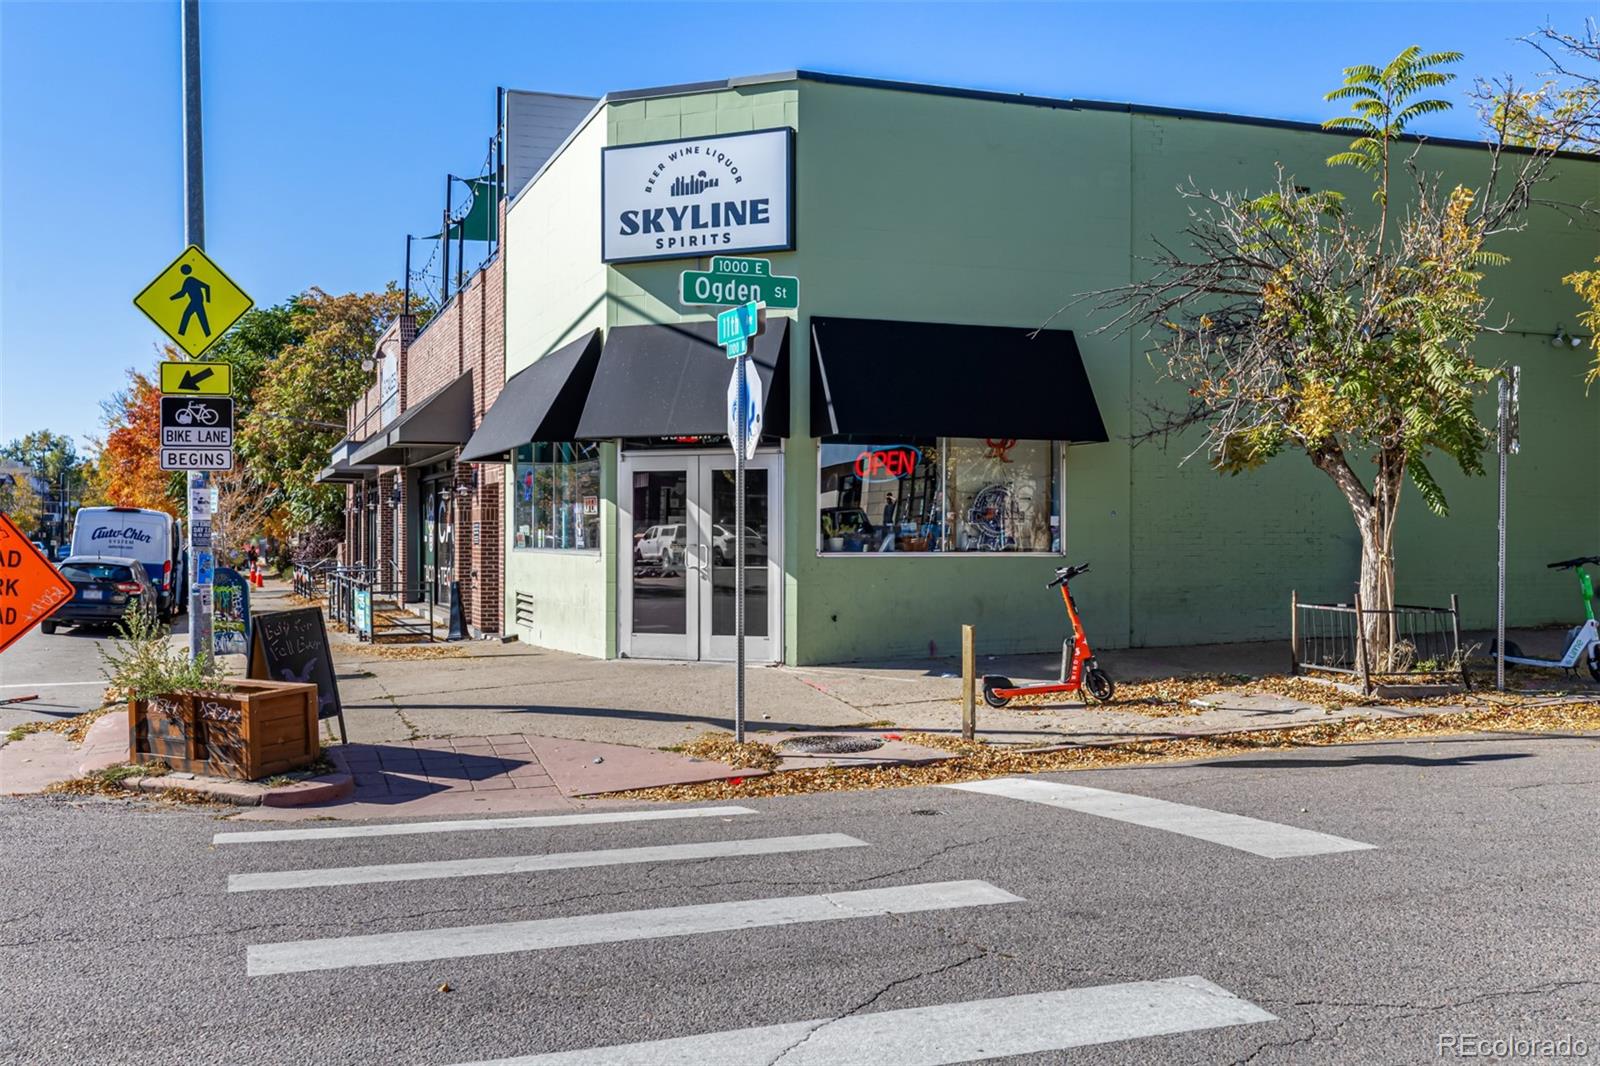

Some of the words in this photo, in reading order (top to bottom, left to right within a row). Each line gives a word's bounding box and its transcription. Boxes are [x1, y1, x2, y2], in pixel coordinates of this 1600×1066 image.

[645, 162, 666, 194] BEER
[668, 146, 700, 162] WINE
[705, 147, 743, 184] LIQUOR
[619, 198, 770, 236] SKYLINE
[656, 232, 732, 249] SPIRITS
[719, 260, 749, 273] 1000
[755, 262, 763, 274] E
[695, 276, 761, 303] Ogden
[774, 286, 788, 299] St
[166, 429, 192, 443] BIKE
[198, 430, 228, 443] LANE
[168, 453, 225, 466] BEGINS
[854, 450, 916, 477] OPEN
[91, 526, 152, 543] Auto-Chlor
